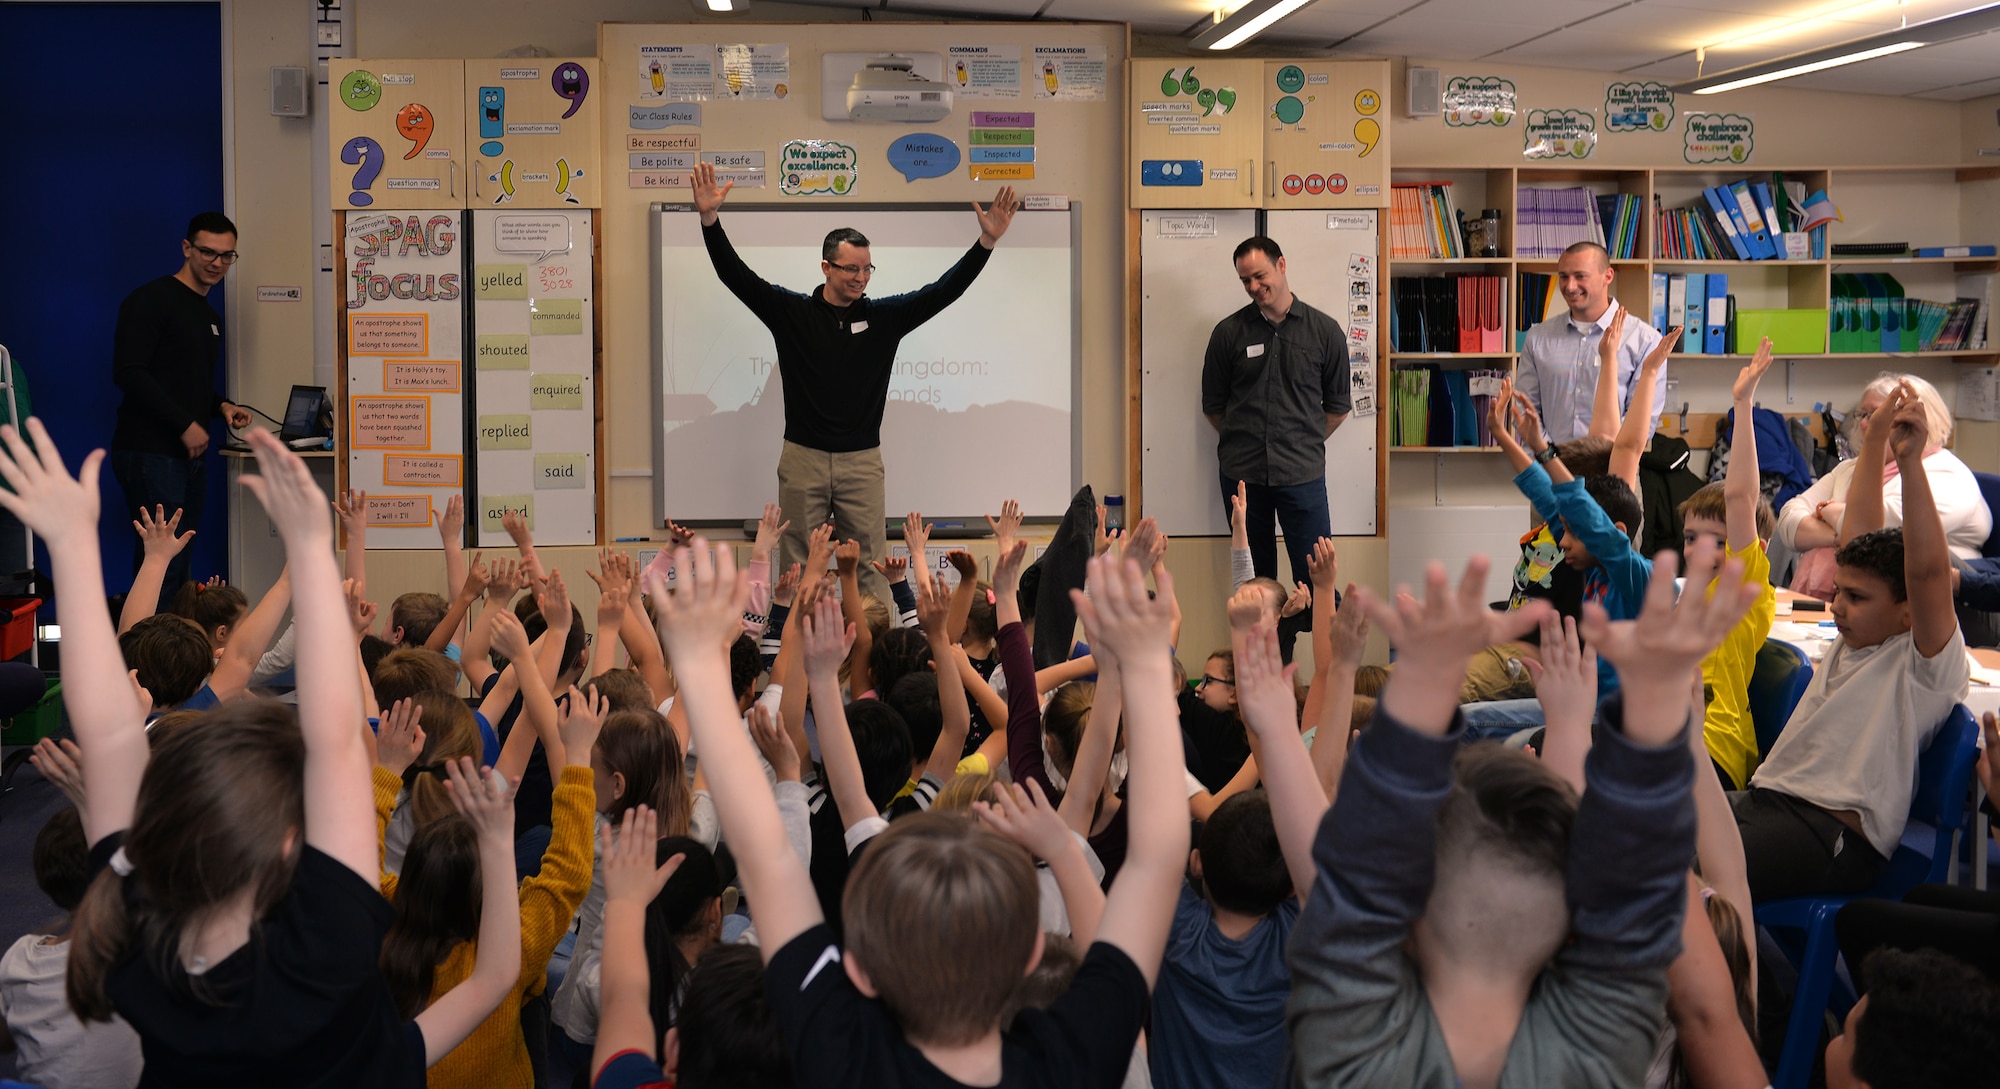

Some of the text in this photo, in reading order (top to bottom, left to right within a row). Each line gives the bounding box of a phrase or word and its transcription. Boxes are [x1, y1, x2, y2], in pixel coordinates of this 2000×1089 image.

[632, 112, 692, 120] Our Class Rules
[985, 115, 1020, 123] Expected
[1692, 122, 1748, 132] We embrace
[984, 133, 1021, 141] Respected
[632, 137, 697, 150] Be respectful
[905, 143, 944, 153] Mistakes
[790, 149, 847, 161] We expect
[984, 150, 1021, 158] Inspected
[641, 157, 683, 168] Be polite
[715, 155, 751, 165] Be safe
[787, 160, 849, 171] excellence.
[726, 174, 736, 183] try
[1211, 170, 1237, 178] hyphen
[387, 180, 418, 188] question
[644, 176, 679, 185] Be kind
[1356, 185, 1379, 194] ellipsis
[1333, 216, 1364, 224] Timetable
[350, 218, 386, 235] Apostrophe
[1166, 220, 1210, 231] Topic Words
[354, 215, 456, 257] SPAG
[539, 266, 568, 279] 3801
[346, 257, 460, 309] focus
[481, 272, 523, 292] yelled
[540, 279, 573, 293] 3028
[532, 311, 580, 320] commanded
[365, 320, 401, 328] apostrophe
[384, 331, 417, 339] something
[357, 341, 381, 349] belongs
[479, 344, 528, 356] shouted
[412, 366, 434, 374] Holly's
[435, 366, 448, 374] toy.
[749, 357, 989, 380] Th ingdom:
[533, 384, 580, 398] enquired
[888, 385, 942, 403] onds
[393, 424, 422, 432] squashed
[481, 424, 529, 442] replied
[545, 464, 574, 478] said
